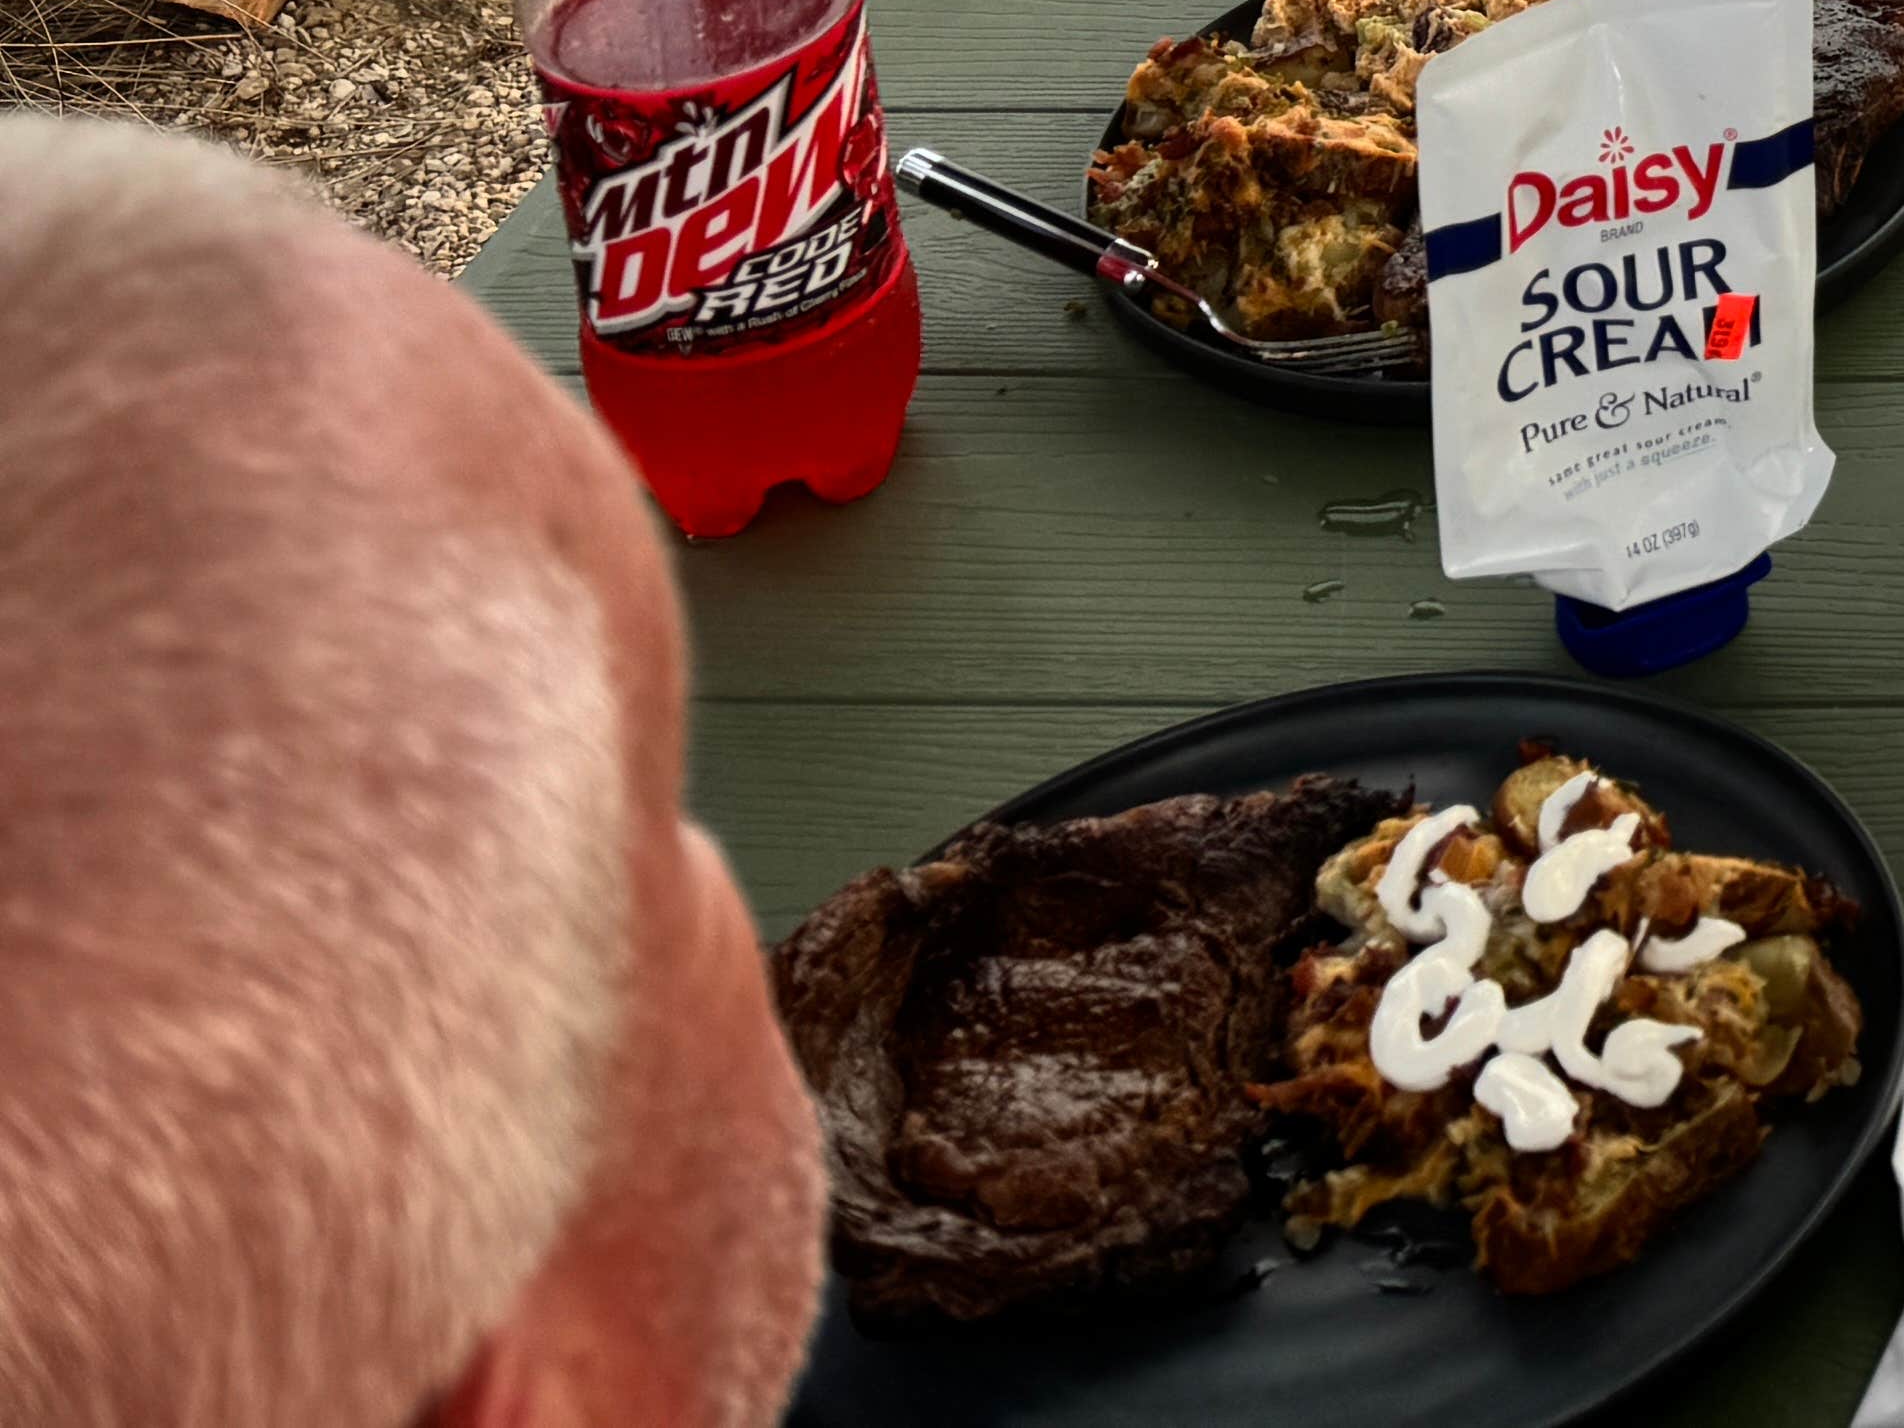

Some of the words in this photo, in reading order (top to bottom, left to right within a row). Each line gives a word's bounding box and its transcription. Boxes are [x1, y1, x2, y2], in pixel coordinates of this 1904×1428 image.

[1508, 142, 1725, 255] Daisy
[1600, 221, 1644, 243] BRAND
[732, 204, 862, 282] CODE
[694, 242, 853, 322] RED
[1521, 238, 1733, 333] SOUR
[1519, 413, 1588, 454] Pure
[1594, 391, 1636, 430] &
[1642, 377, 1751, 416] Natural
[1586, 443, 1629, 469] great
[1636, 431, 1672, 452] sour
[1593, 461, 1622, 490] just
[1625, 459, 1636, 473] a
[1625, 539, 1641, 560] 14
[1642, 534, 1659, 554] OZ
[1661, 518, 1701, 550] (397g)
